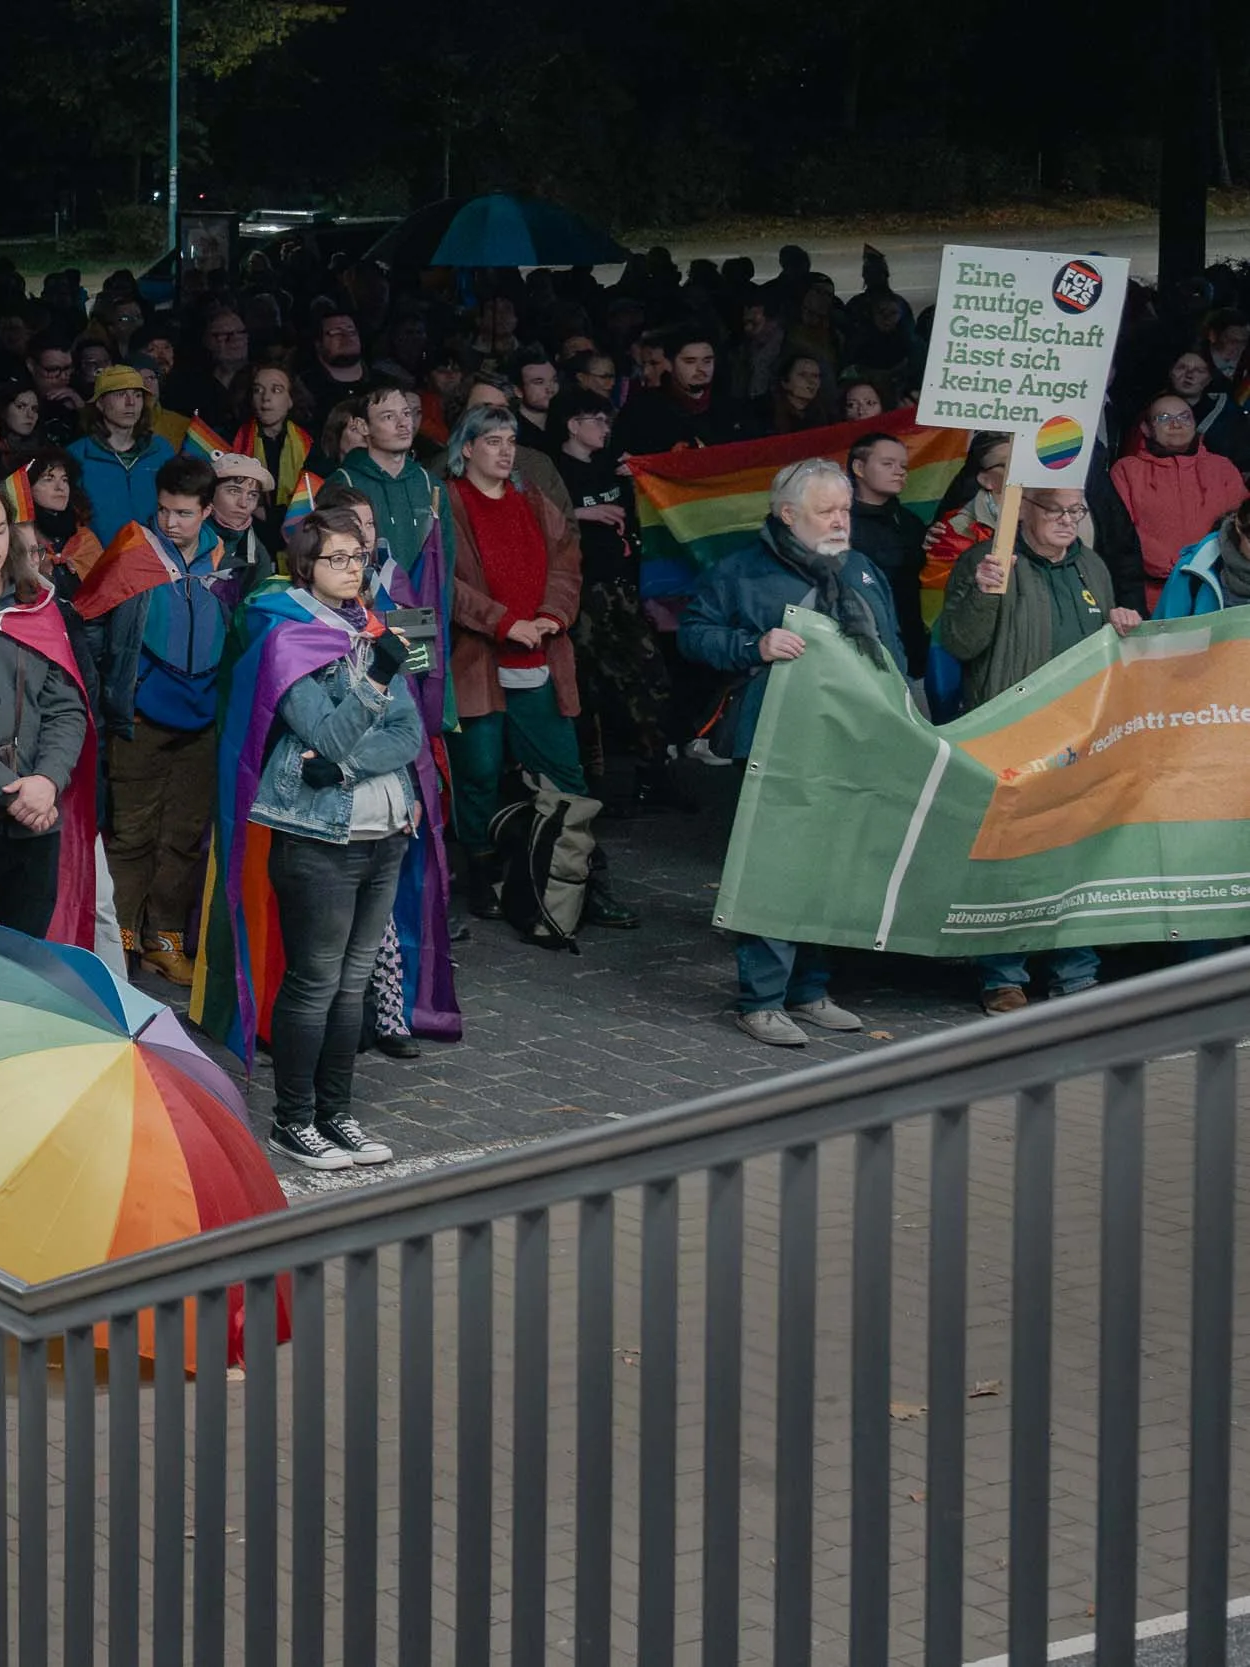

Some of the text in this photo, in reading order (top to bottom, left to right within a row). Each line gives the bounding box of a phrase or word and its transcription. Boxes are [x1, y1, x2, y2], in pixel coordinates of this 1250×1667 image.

[956, 262, 1016, 288] Eine
[1062, 267, 1099, 295] FCK
[952, 291, 1044, 319] mutige
[1056, 280, 1092, 306] NZS
[950, 315, 1104, 348] Gesellschaft
[943, 341, 1061, 371] lässt sich
[939, 367, 1089, 403] keine Angst
[934, 398, 1045, 423] machen.
[945, 910, 1007, 924] BÜNDNIS
[1086, 886, 1228, 904] Mecklenburgische
